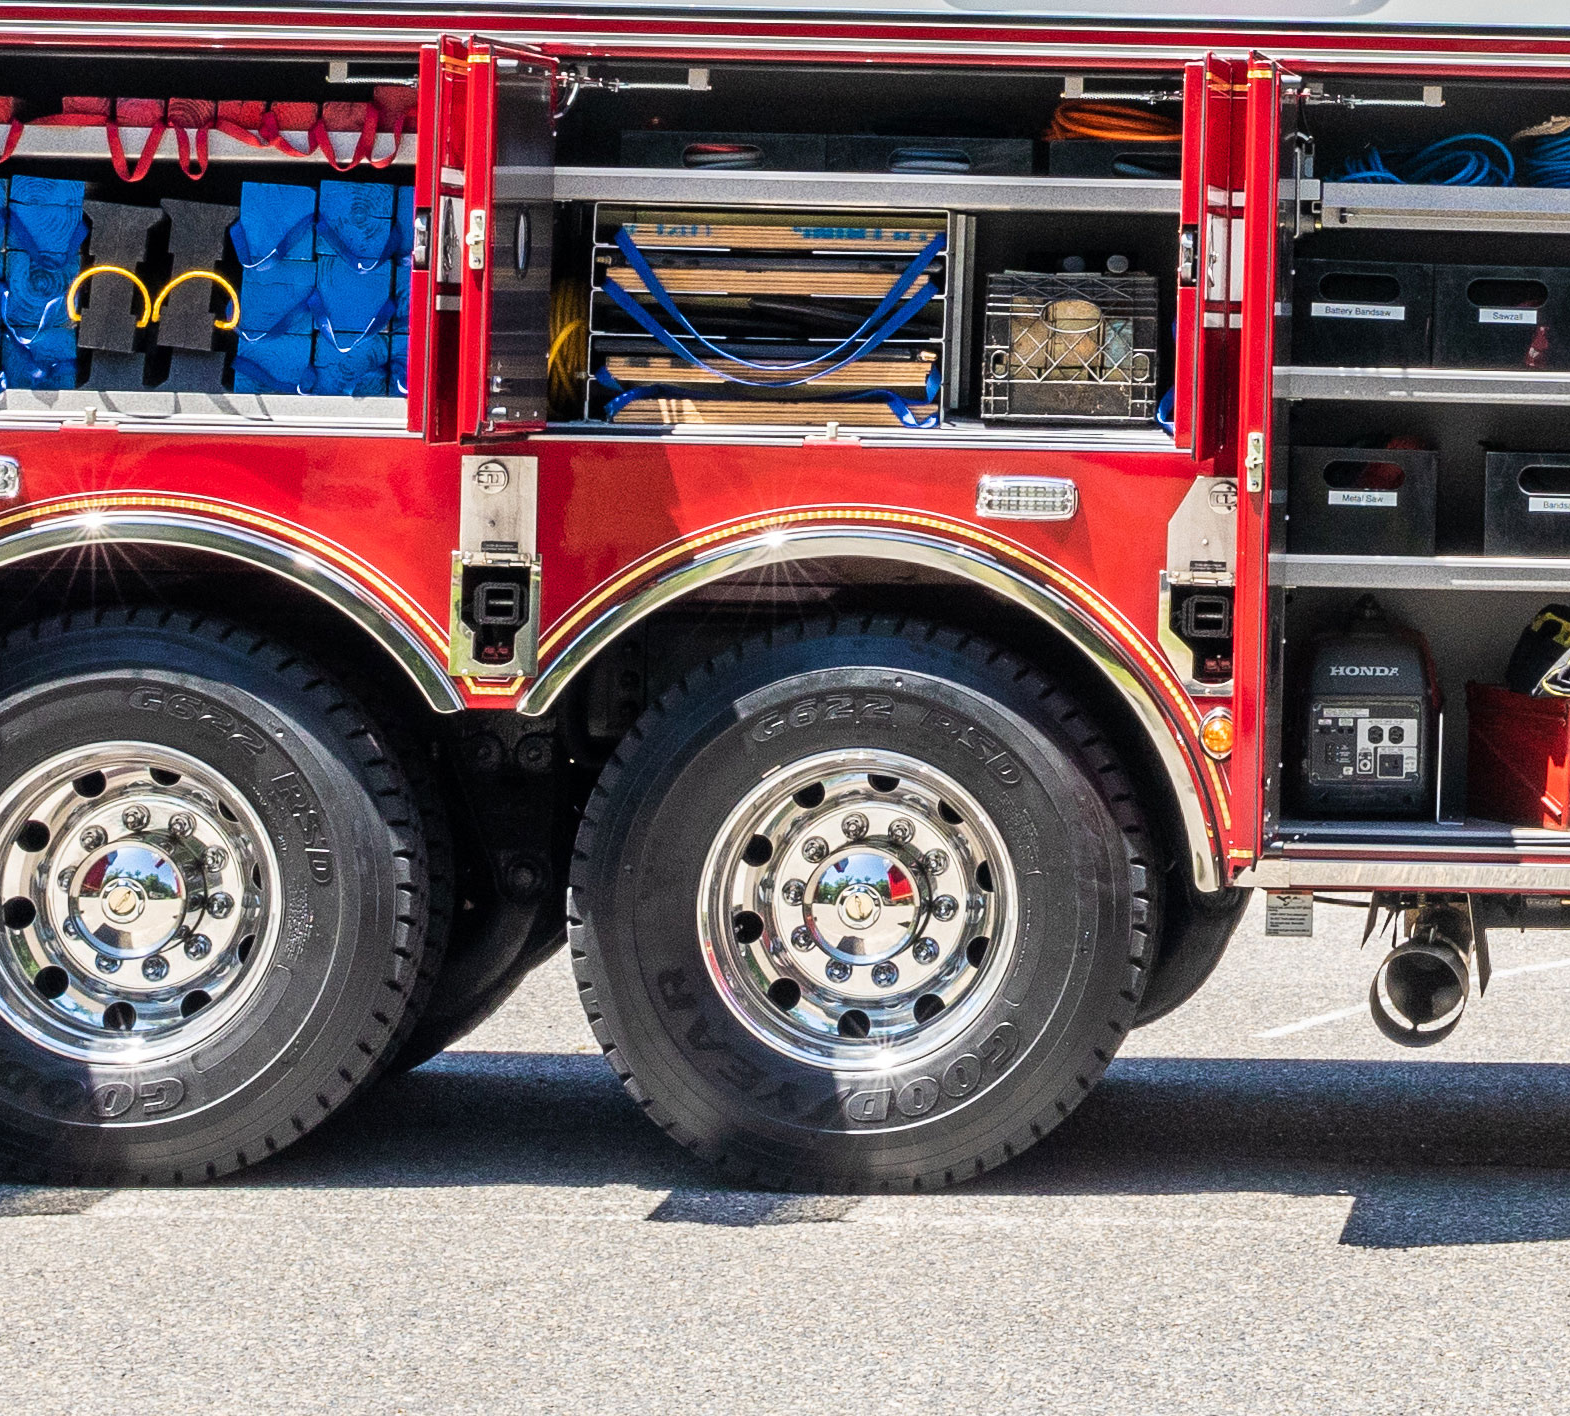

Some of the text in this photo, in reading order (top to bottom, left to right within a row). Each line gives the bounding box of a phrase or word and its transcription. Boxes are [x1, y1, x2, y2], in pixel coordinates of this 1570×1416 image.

[1324, 305, 1392, 317] Battery Bandsaw
[1492, 311, 1524, 321] Sawzall
[1341, 493, 1384, 504] Metal Saw
[1330, 666, 1400, 676] HONDA
[129, 685, 267, 756] G622
[751, 693, 896, 742] G622
